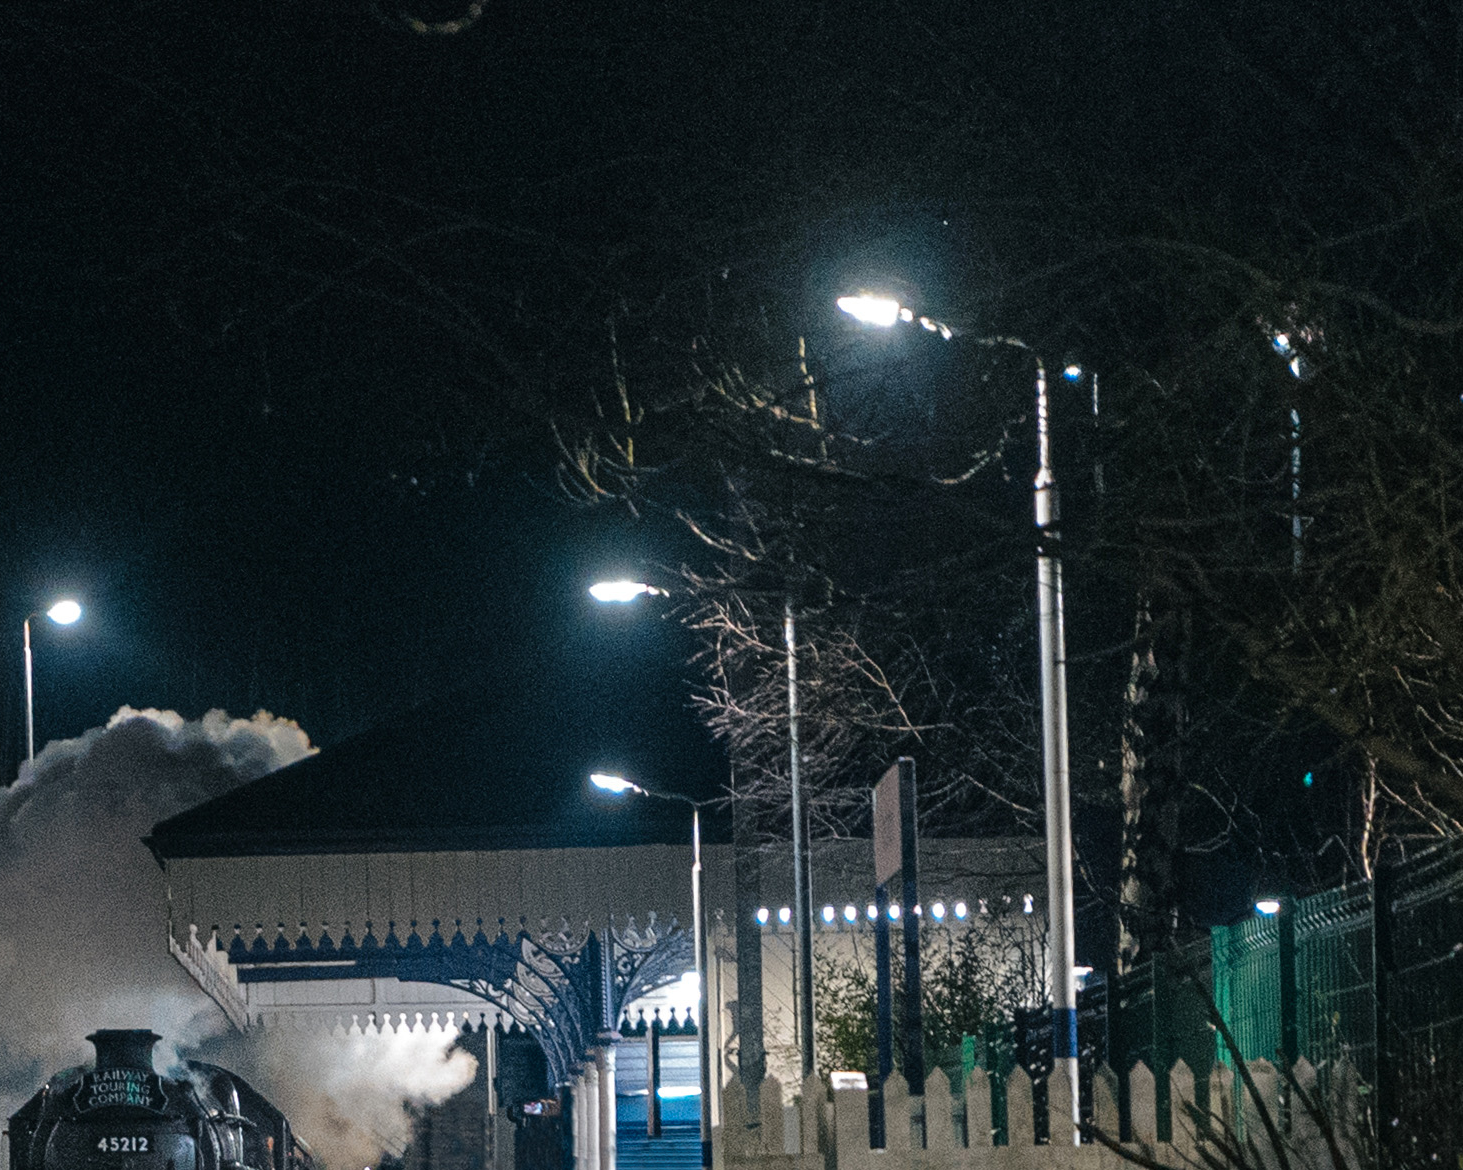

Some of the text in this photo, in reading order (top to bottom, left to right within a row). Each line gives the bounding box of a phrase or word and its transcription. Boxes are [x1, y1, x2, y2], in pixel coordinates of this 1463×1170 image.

[93, 1069, 149, 1082] RAILWAY
[90, 1081, 151, 1095] TOURING
[88, 1091, 153, 1106] COMPANY
[97, 1136, 149, 1152] 45212
